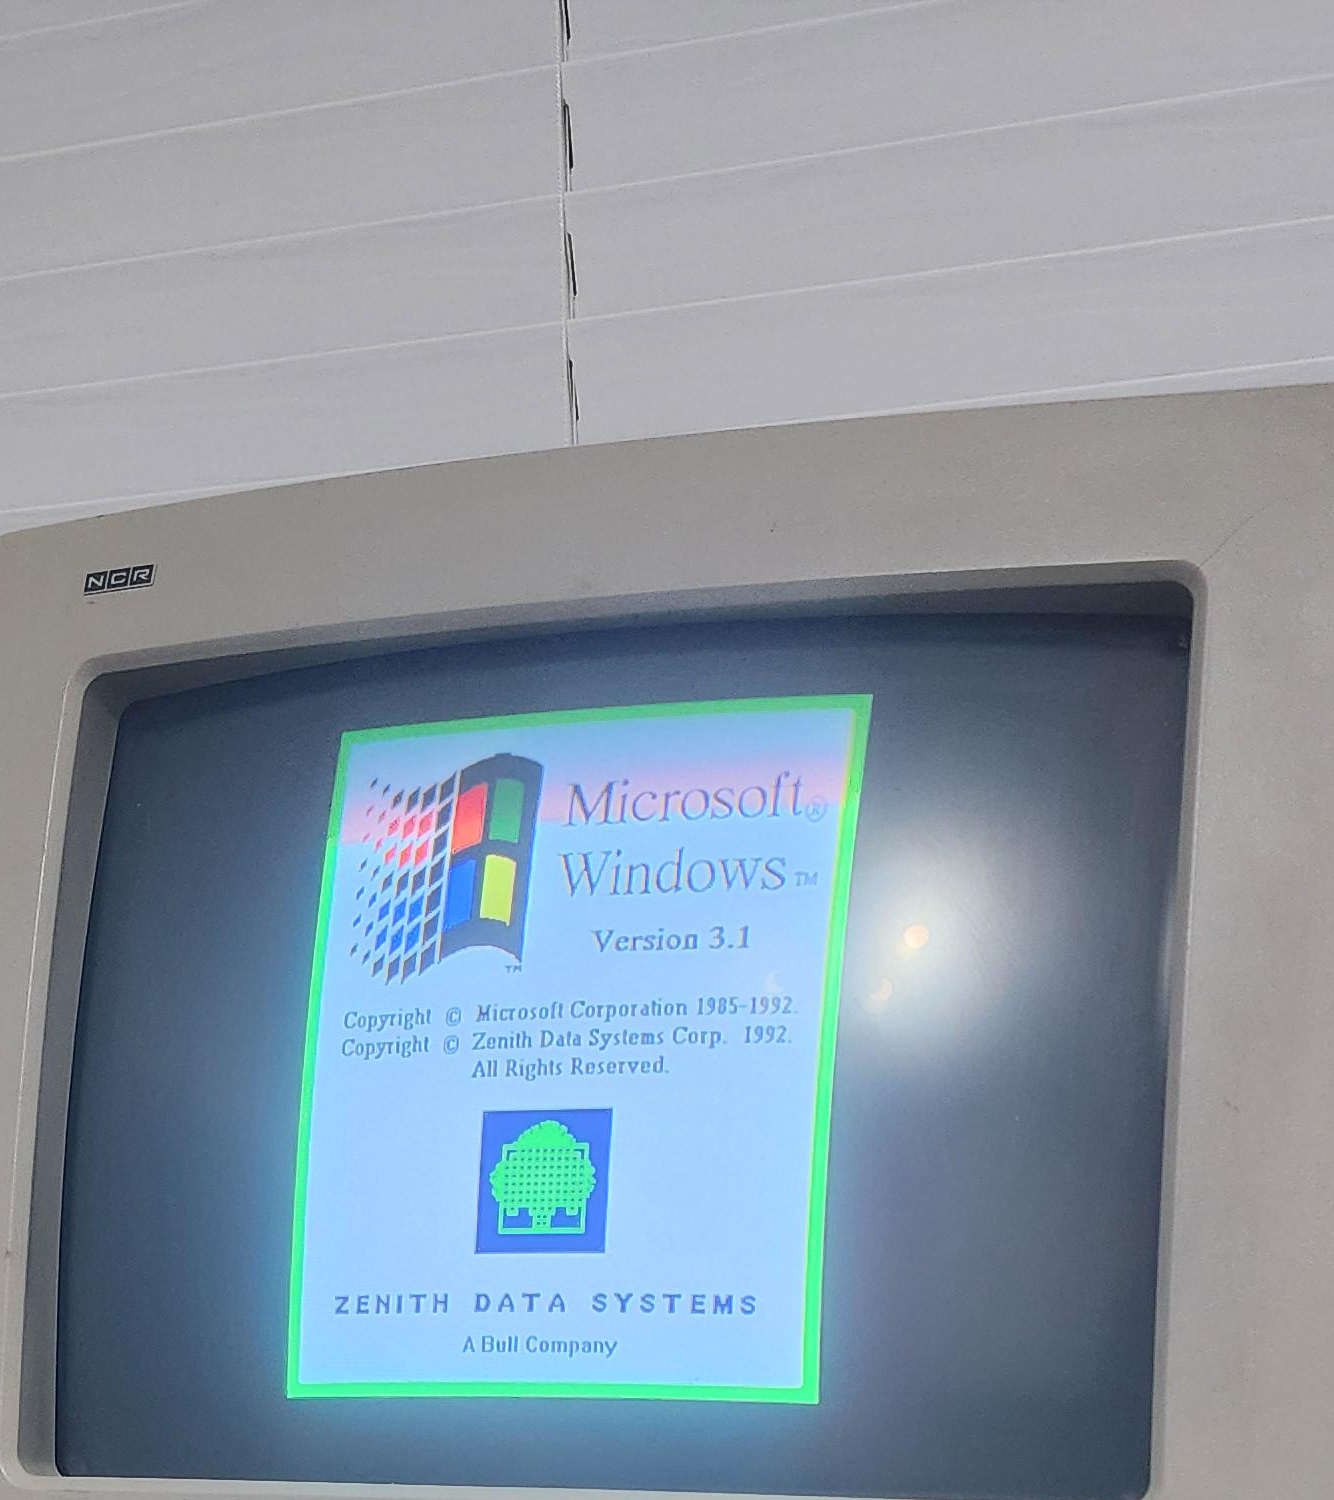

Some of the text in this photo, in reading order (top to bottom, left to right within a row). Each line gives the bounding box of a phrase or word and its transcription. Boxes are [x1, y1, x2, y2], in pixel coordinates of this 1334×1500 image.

[85, 566, 153, 591] NCR
[557, 846, 787, 898] Windows
[591, 925, 750, 953] Version 3.1
[343, 1007, 432, 1033] Copyright
[475, 1001, 564, 1023] Microsoft
[570, 997, 688, 1023] Corporation
[696, 996, 798, 1016] 1985-1992.
[341, 1035, 430, 1061] Copyright
[471, 1029, 533, 1051] Zenith
[539, 1029, 582, 1048] Data
[588, 1028, 665, 1051] Systems
[672, 1026, 728, 1050] Corp.
[743, 1025, 793, 1045] 1992.
[471, 1055, 669, 1081] All Rights Reserved.
[334, 1291, 758, 1316] ZENITH DATA SYSTEMS
[462, 1334, 619, 1359] A Bull Company
